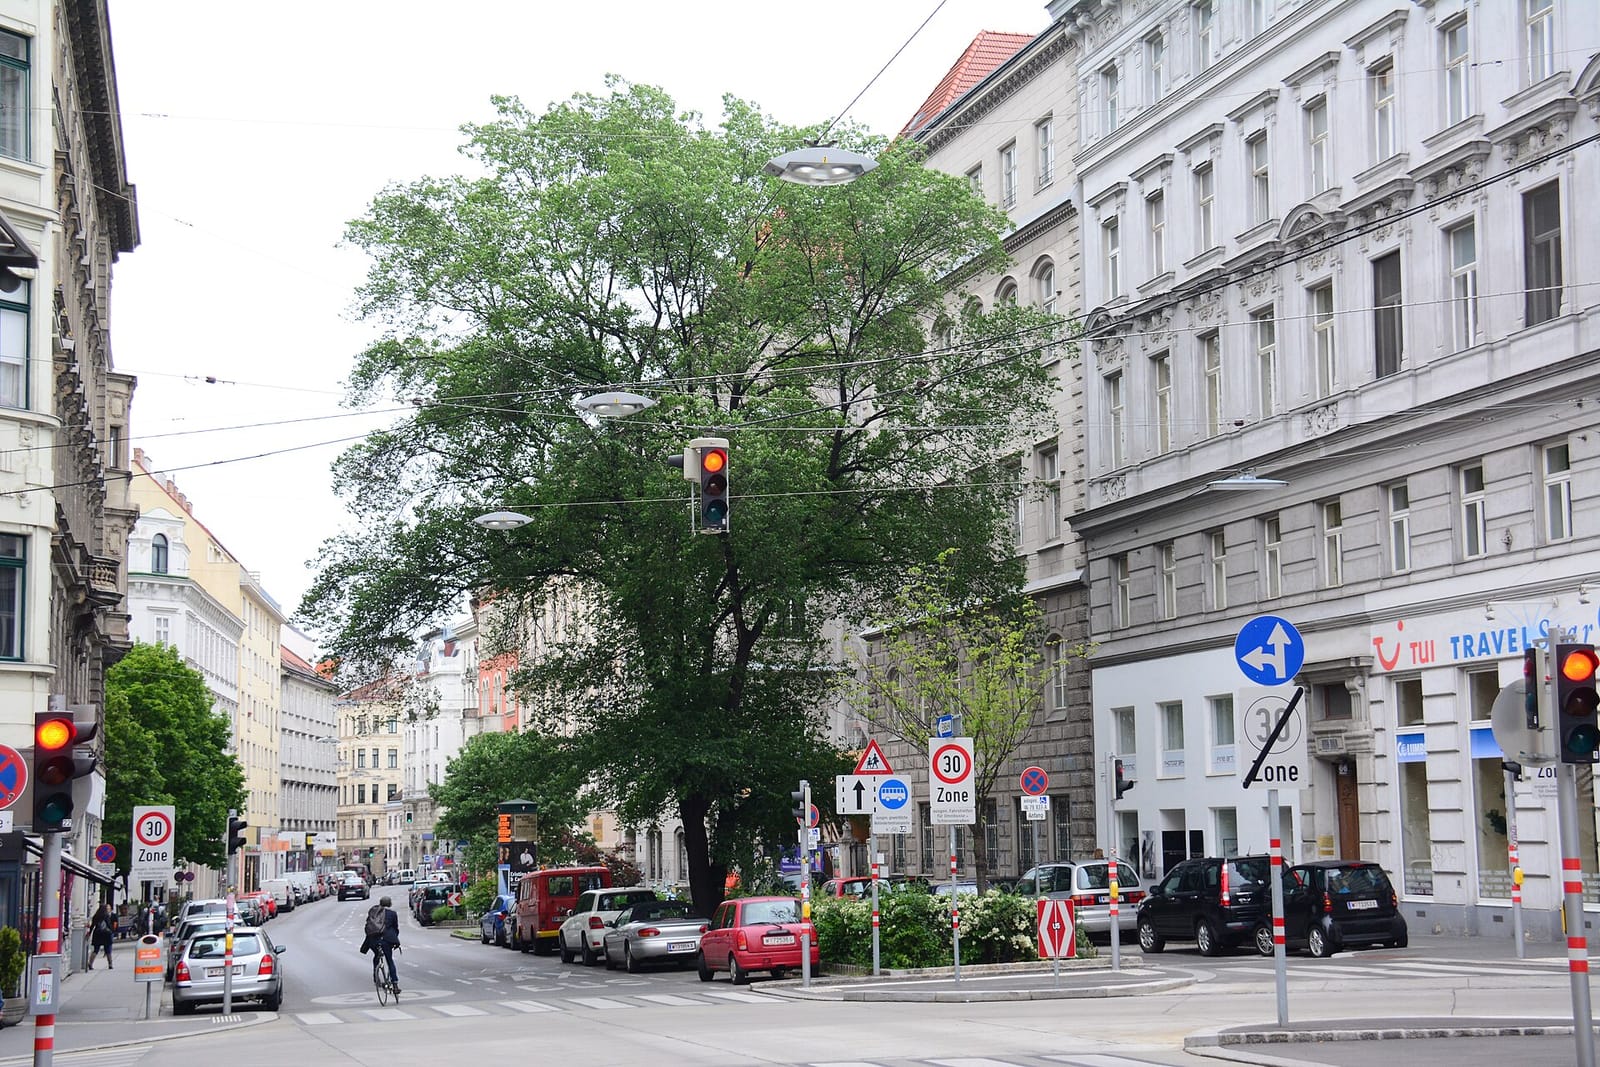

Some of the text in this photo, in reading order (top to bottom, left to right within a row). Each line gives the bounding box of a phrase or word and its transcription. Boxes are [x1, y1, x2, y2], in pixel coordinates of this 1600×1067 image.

[1410, 639, 1435, 665] TUI
[1256, 707, 1291, 743] 30
[943, 755, 961, 773] 30
[937, 787, 969, 803] Zone
[146, 821, 163, 837] 30
[138, 848, 168, 862] Zone
